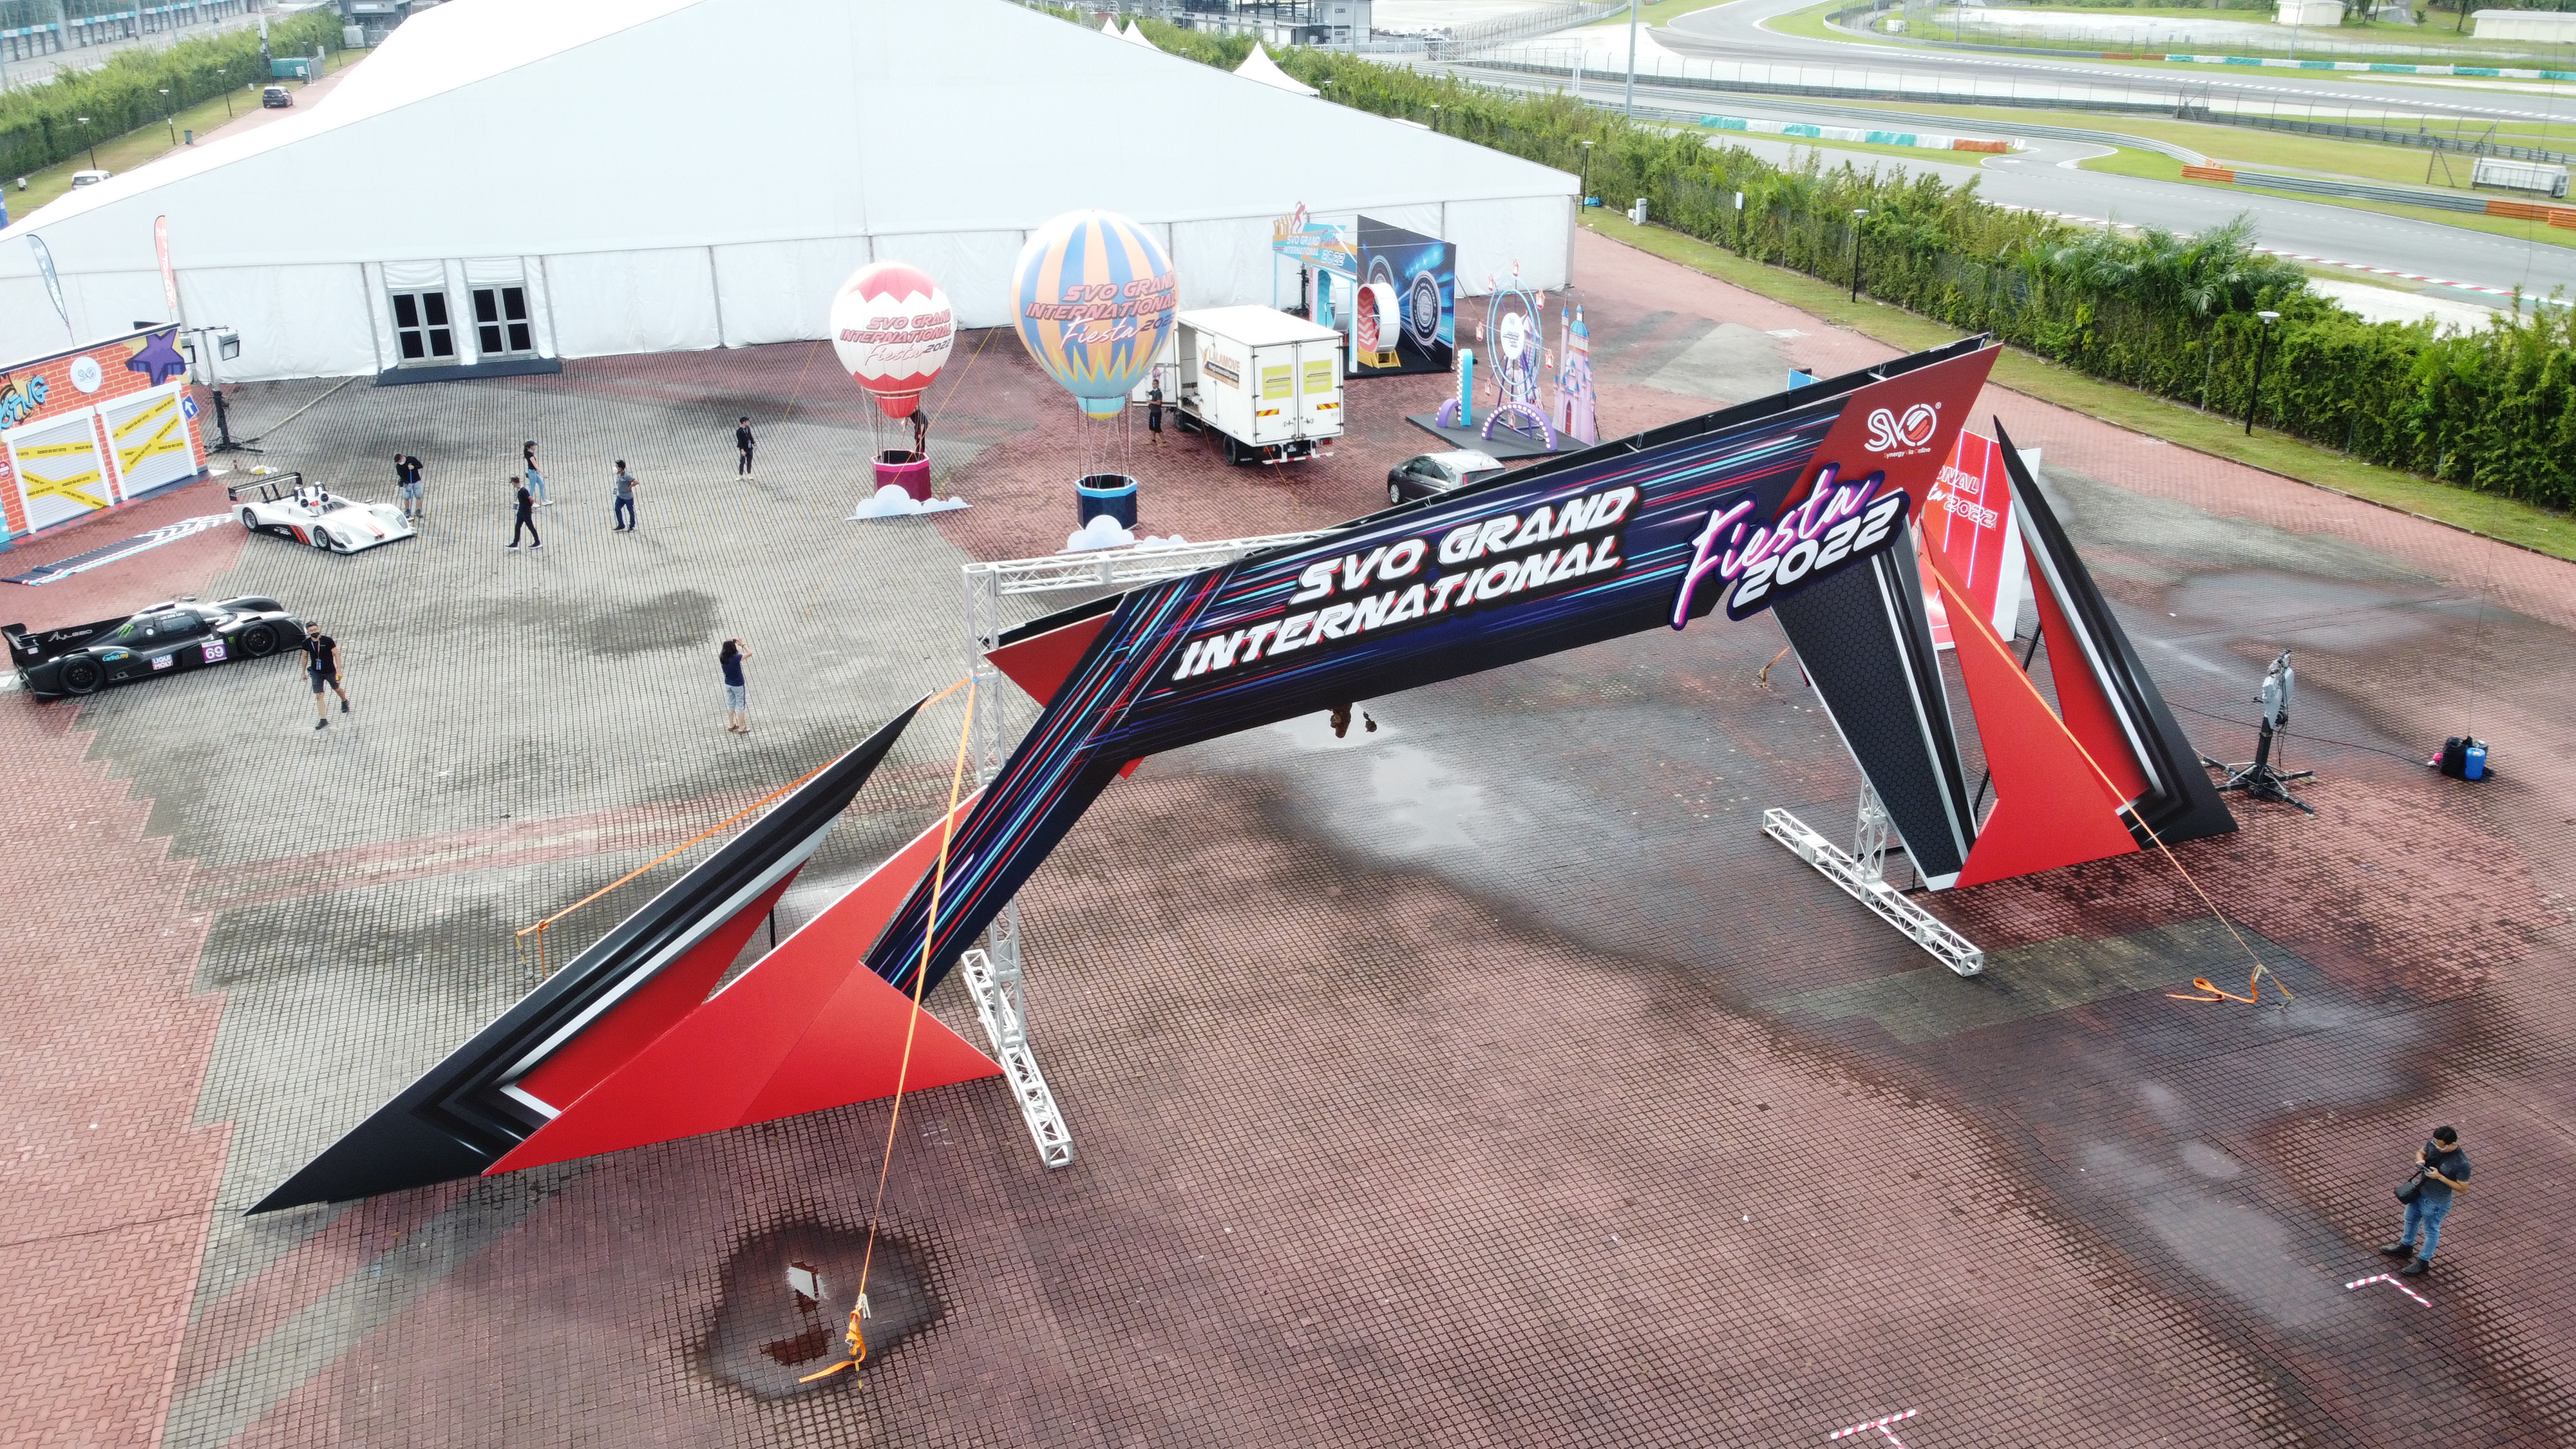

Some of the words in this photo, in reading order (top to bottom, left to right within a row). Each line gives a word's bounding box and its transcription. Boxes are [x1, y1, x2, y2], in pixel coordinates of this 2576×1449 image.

[1320, 249, 1345, 266] 2022
[1062, 283, 1119, 302] SVO
[1122, 270, 1175, 298] GRAND
[866, 317, 909, 330] SVO
[911, 308, 951, 328] GRAND
[1025, 290, 1176, 321] INTERNATIONAL
[840, 323, 952, 344] INTERNATIONAL
[923, 338, 951, 353] 2022
[1060, 316, 1144, 350] Fiesta
[865, 340, 925, 366] Fiesta
[1864, 403, 1937, 451] SVO
[1883, 451, 1905, 459] Synergy
[1944, 495, 1998, 528] 2022
[1289, 537, 1429, 607] SVO
[1437, 485, 1640, 566] GRAND
[1674, 468, 1874, 626] Fiesta
[1732, 497, 1900, 609] 2022
[1171, 535, 1622, 681] INTERNATIONAL
[153, 654, 172, 664] LIQUI
[154, 660, 173, 671] MOLY
[205, 645, 224, 659] 69
